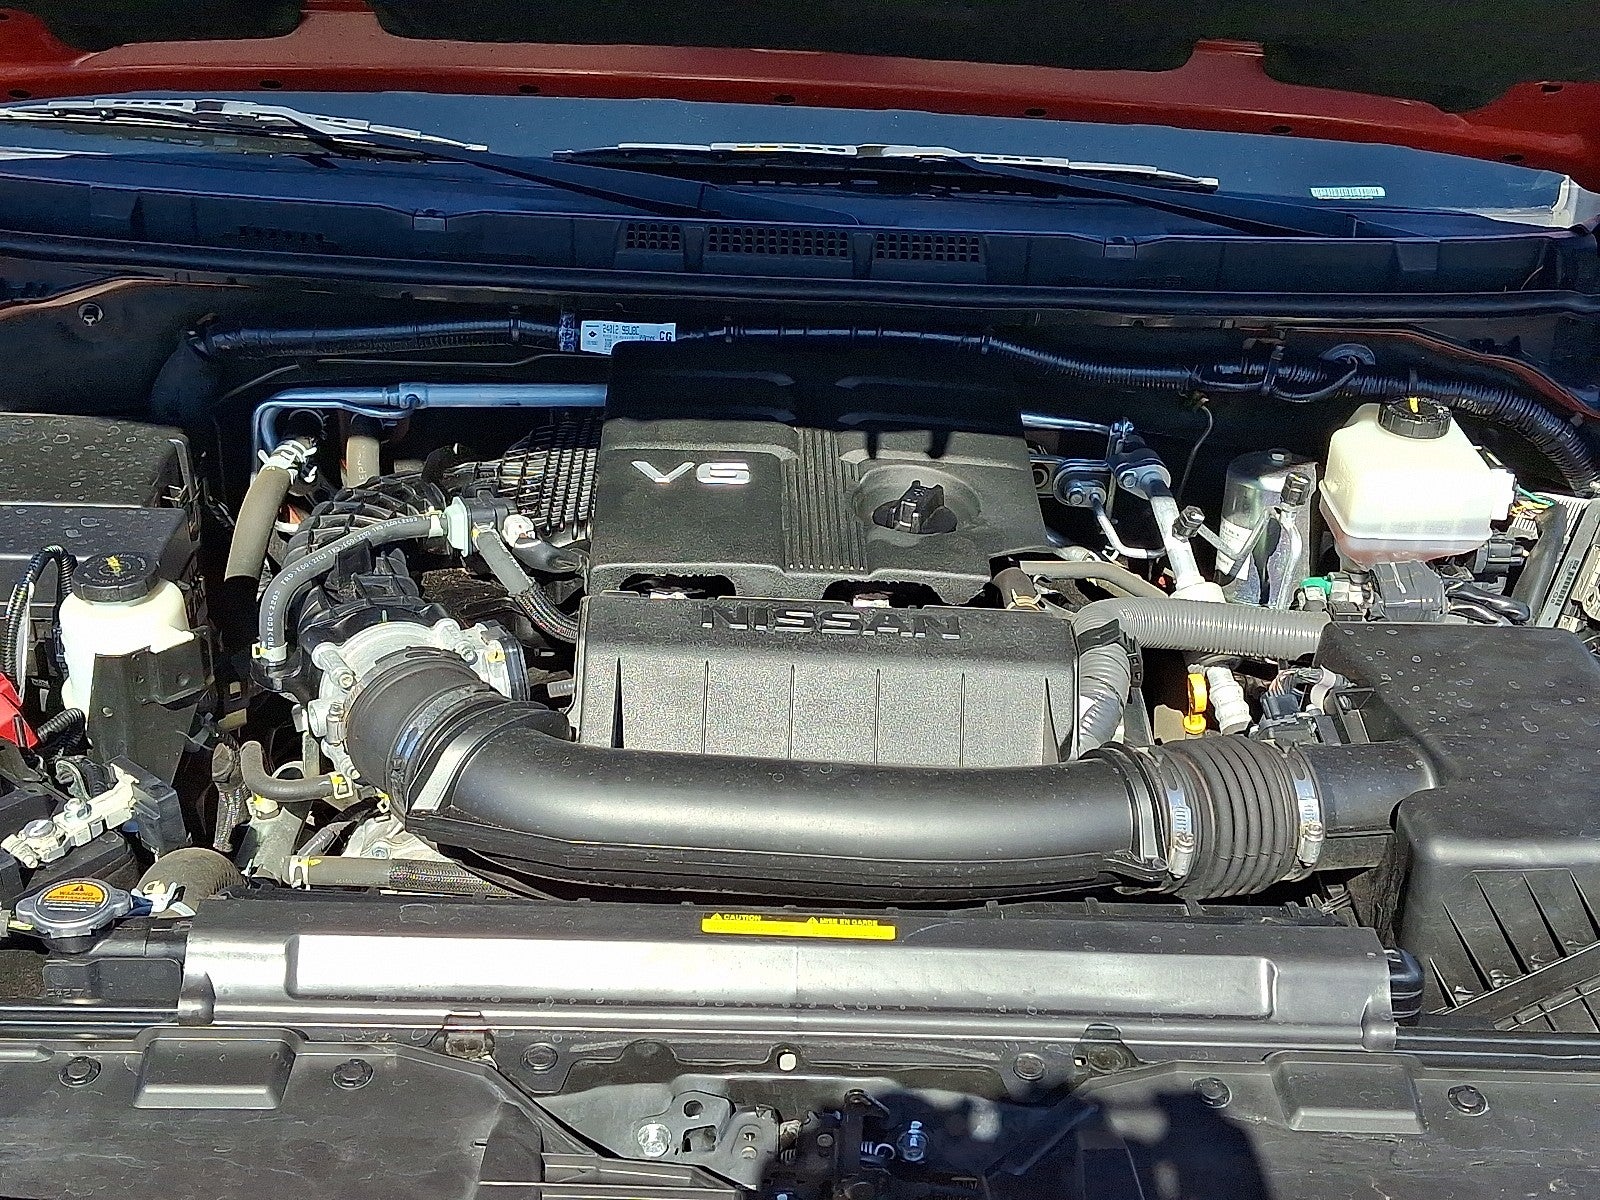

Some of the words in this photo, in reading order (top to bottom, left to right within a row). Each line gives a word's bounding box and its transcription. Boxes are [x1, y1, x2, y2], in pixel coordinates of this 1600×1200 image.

[659, 330, 673, 342] CG
[631, 460, 751, 485] V6
[701, 604, 961, 641] NISSAN
[723, 914, 762, 922] CAUTION
[819, 917, 838, 925] MISE
[839, 918, 851, 926] EN
[851, 919, 878, 927] GARDE
